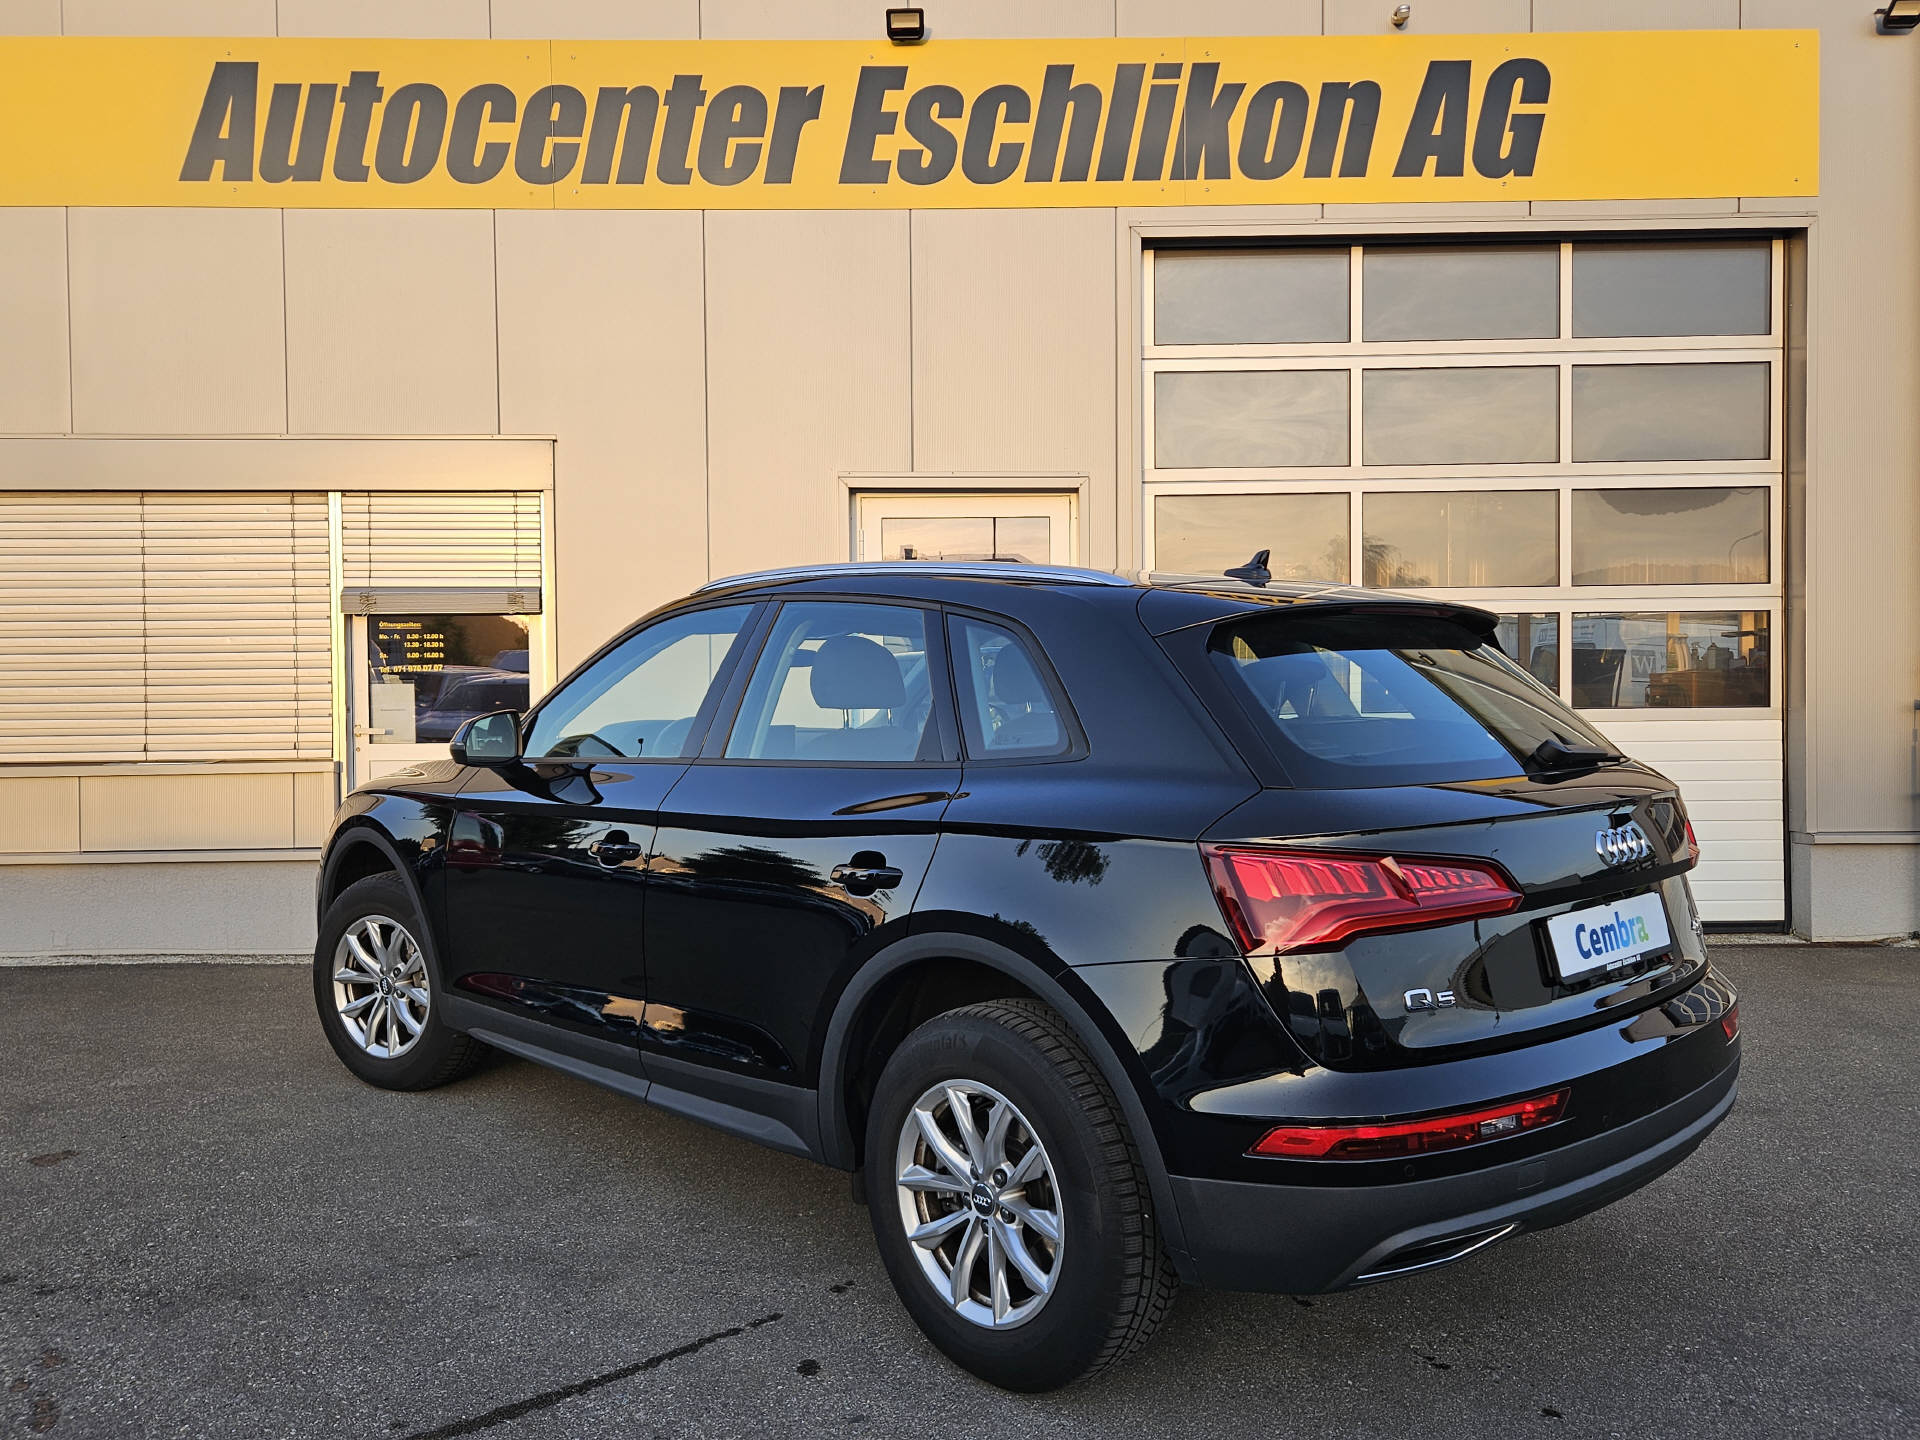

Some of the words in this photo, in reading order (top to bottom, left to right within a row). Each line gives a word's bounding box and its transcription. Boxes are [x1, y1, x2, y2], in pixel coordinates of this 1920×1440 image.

[177, 61, 825, 187] Autocenter
[838, 61, 1382, 185] Eschlikon
[1391, 57, 1551, 179] AG
[1575, 911, 1649, 960] Cembra
[1403, 988, 1456, 1012] Q5
